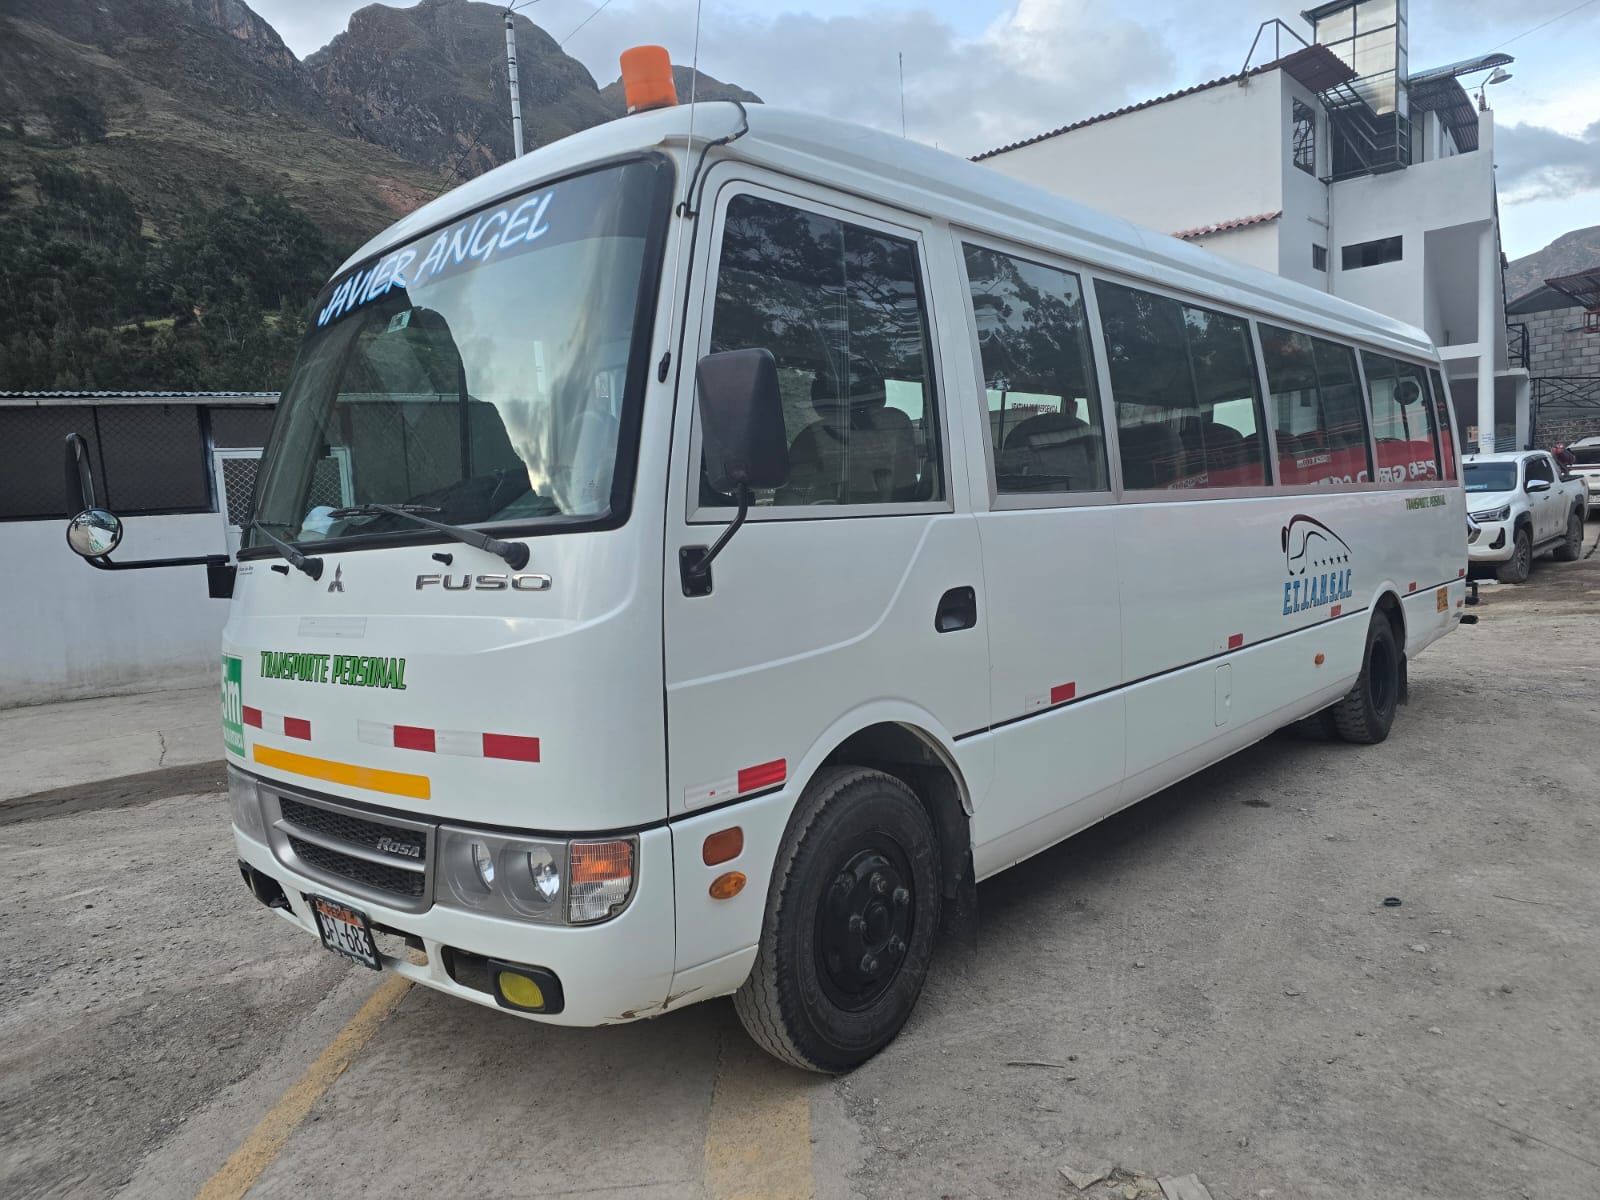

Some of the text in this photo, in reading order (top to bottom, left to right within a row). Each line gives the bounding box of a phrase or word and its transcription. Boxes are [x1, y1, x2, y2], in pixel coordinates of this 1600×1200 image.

[317, 191, 553, 327] JAVIER ANGEL
[416, 574, 552, 591] FUSO
[260, 651, 406, 690] TRANSPORTE PERSONAL
